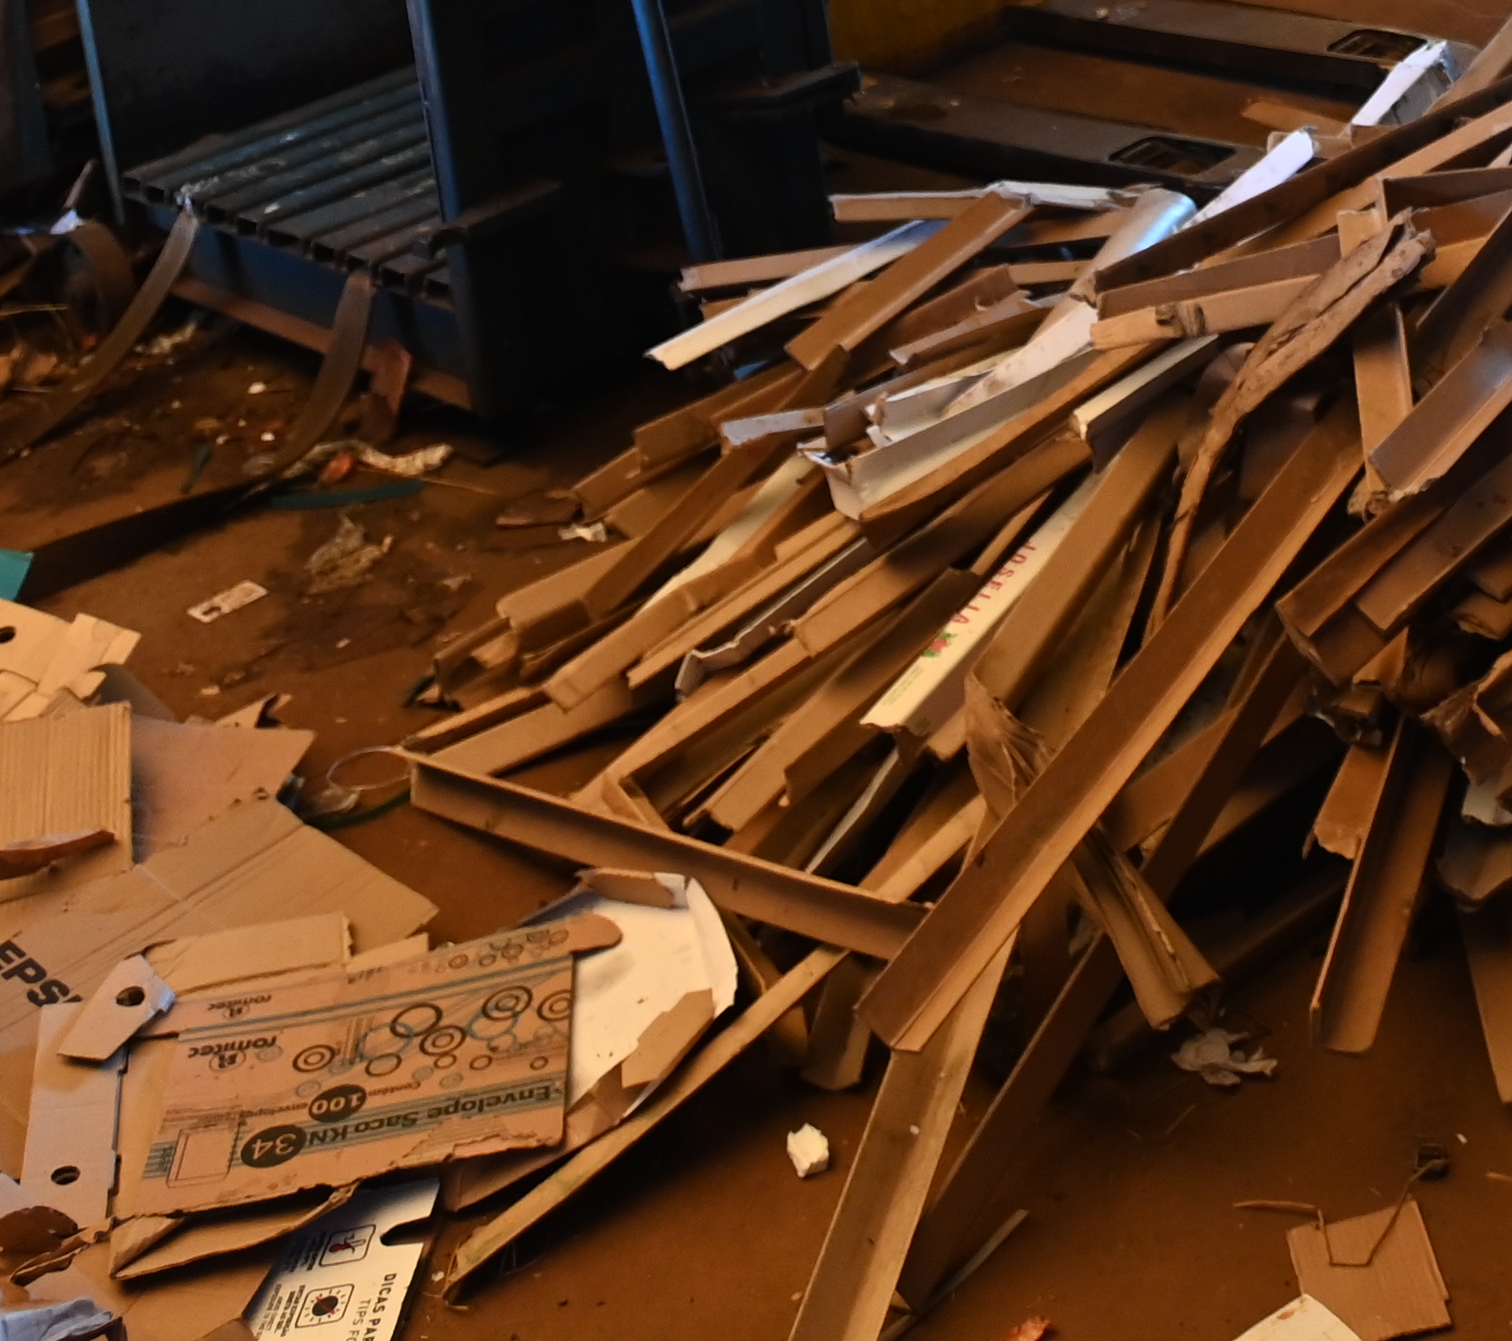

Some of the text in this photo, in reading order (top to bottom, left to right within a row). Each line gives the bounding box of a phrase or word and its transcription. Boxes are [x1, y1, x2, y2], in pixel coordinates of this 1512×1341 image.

[188, 1035, 277, 1058] romitec
[311, 1093, 362, 1115] 100
[251, 1085, 551, 1160] Envelope Saco KN 34
[372, 1273, 397, 1313] DICAS
[352, 1298, 371, 1326] TIPS
